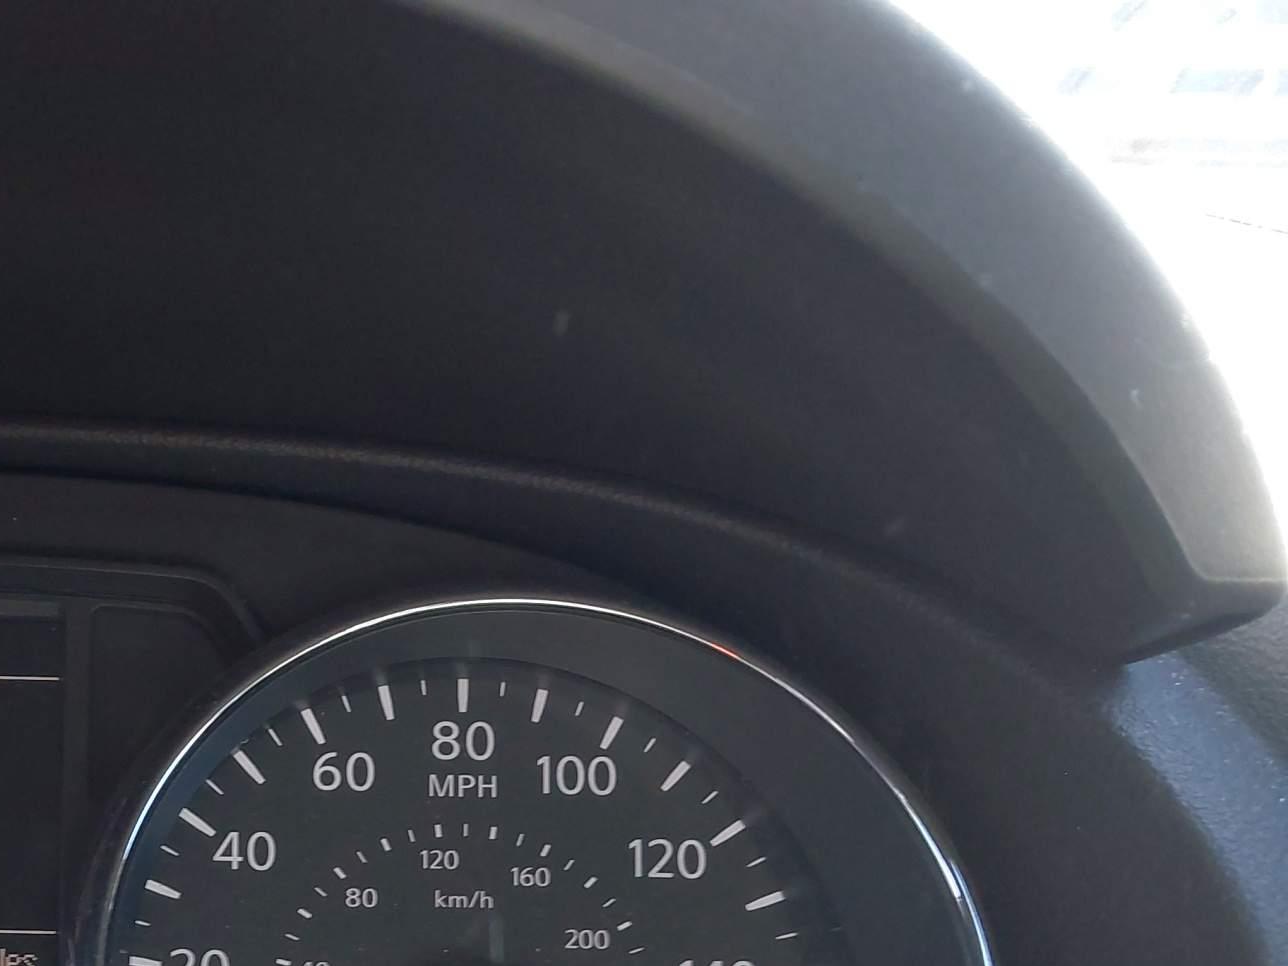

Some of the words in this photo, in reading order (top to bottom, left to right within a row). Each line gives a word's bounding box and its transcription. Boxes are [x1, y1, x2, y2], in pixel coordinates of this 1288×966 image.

[431, 720, 495, 761] 80
[313, 751, 375, 792] 60
[536, 755, 617, 796] 100
[428, 773, 497, 798] MPH
[213, 831, 276, 871] 40
[419, 849, 460, 870] 120
[628, 838, 707, 880] 120
[510, 867, 551, 887] 160
[345, 887, 378, 908] 80
[434, 889, 494, 909] km/h
[564, 928, 610, 950] 200
